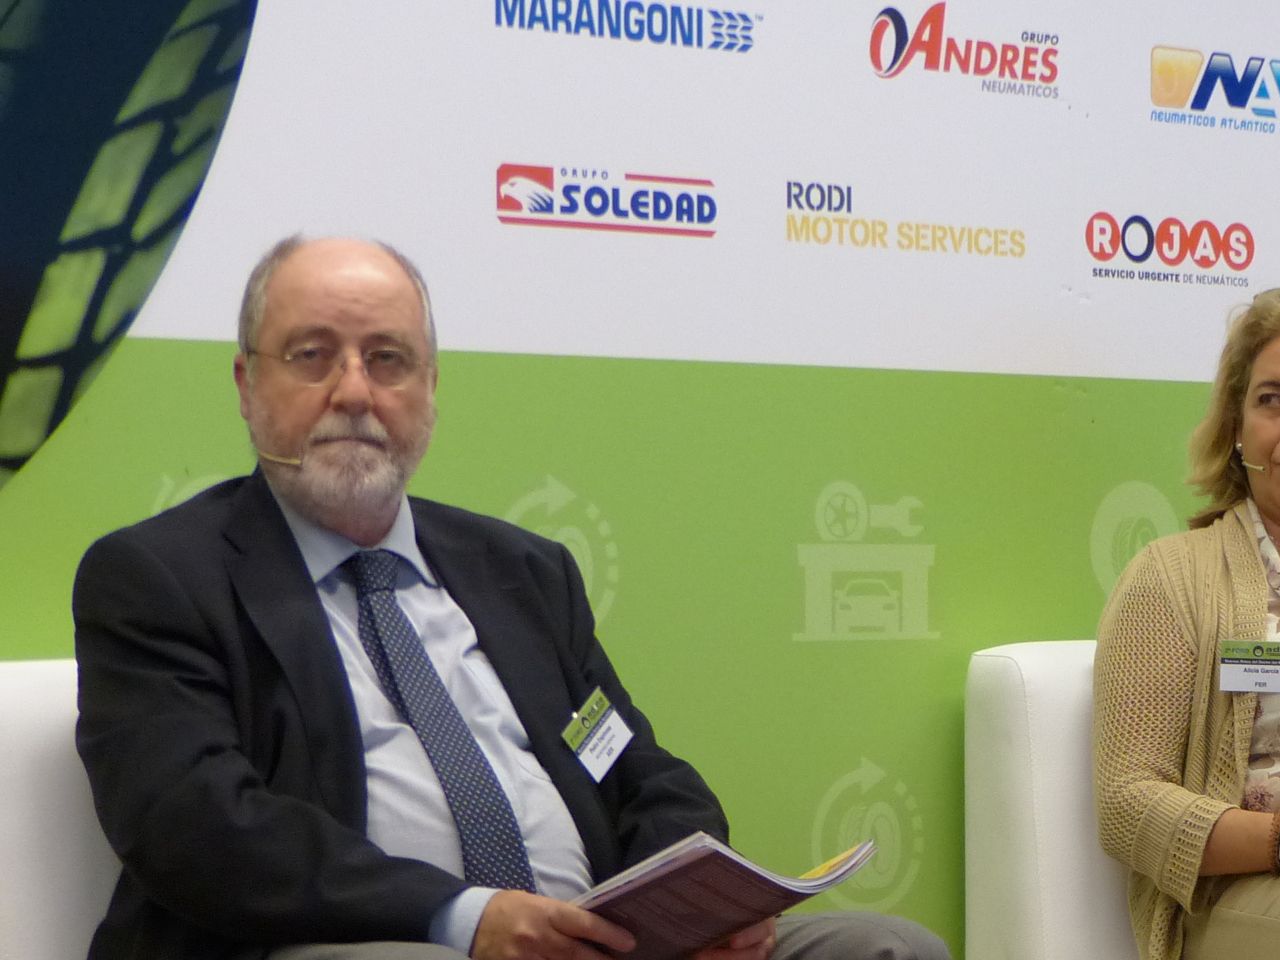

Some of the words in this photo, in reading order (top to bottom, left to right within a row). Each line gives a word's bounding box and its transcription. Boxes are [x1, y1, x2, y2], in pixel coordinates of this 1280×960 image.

[494, 0, 703, 48] MARANGONI
[1021, 31, 1059, 46] GRUPO
[898, 2, 1059, 84] ANDRES
[981, 79, 1059, 99] NEUMATICOS
[560, 168, 609, 180] GRUPO
[560, 184, 717, 224] SOLEDAD
[786, 181, 852, 213] RODI
[786, 214, 888, 249] MOTOR
[896, 221, 1026, 258] SERVICES
[1088, 213, 1253, 270] ROJAS
[1092, 268, 1135, 280] SERVICIO
[1138, 271, 1181, 283] URGENTE
[1183, 274, 1194, 284] DE
[1196, 274, 1249, 288] NEUMÁTICOS
